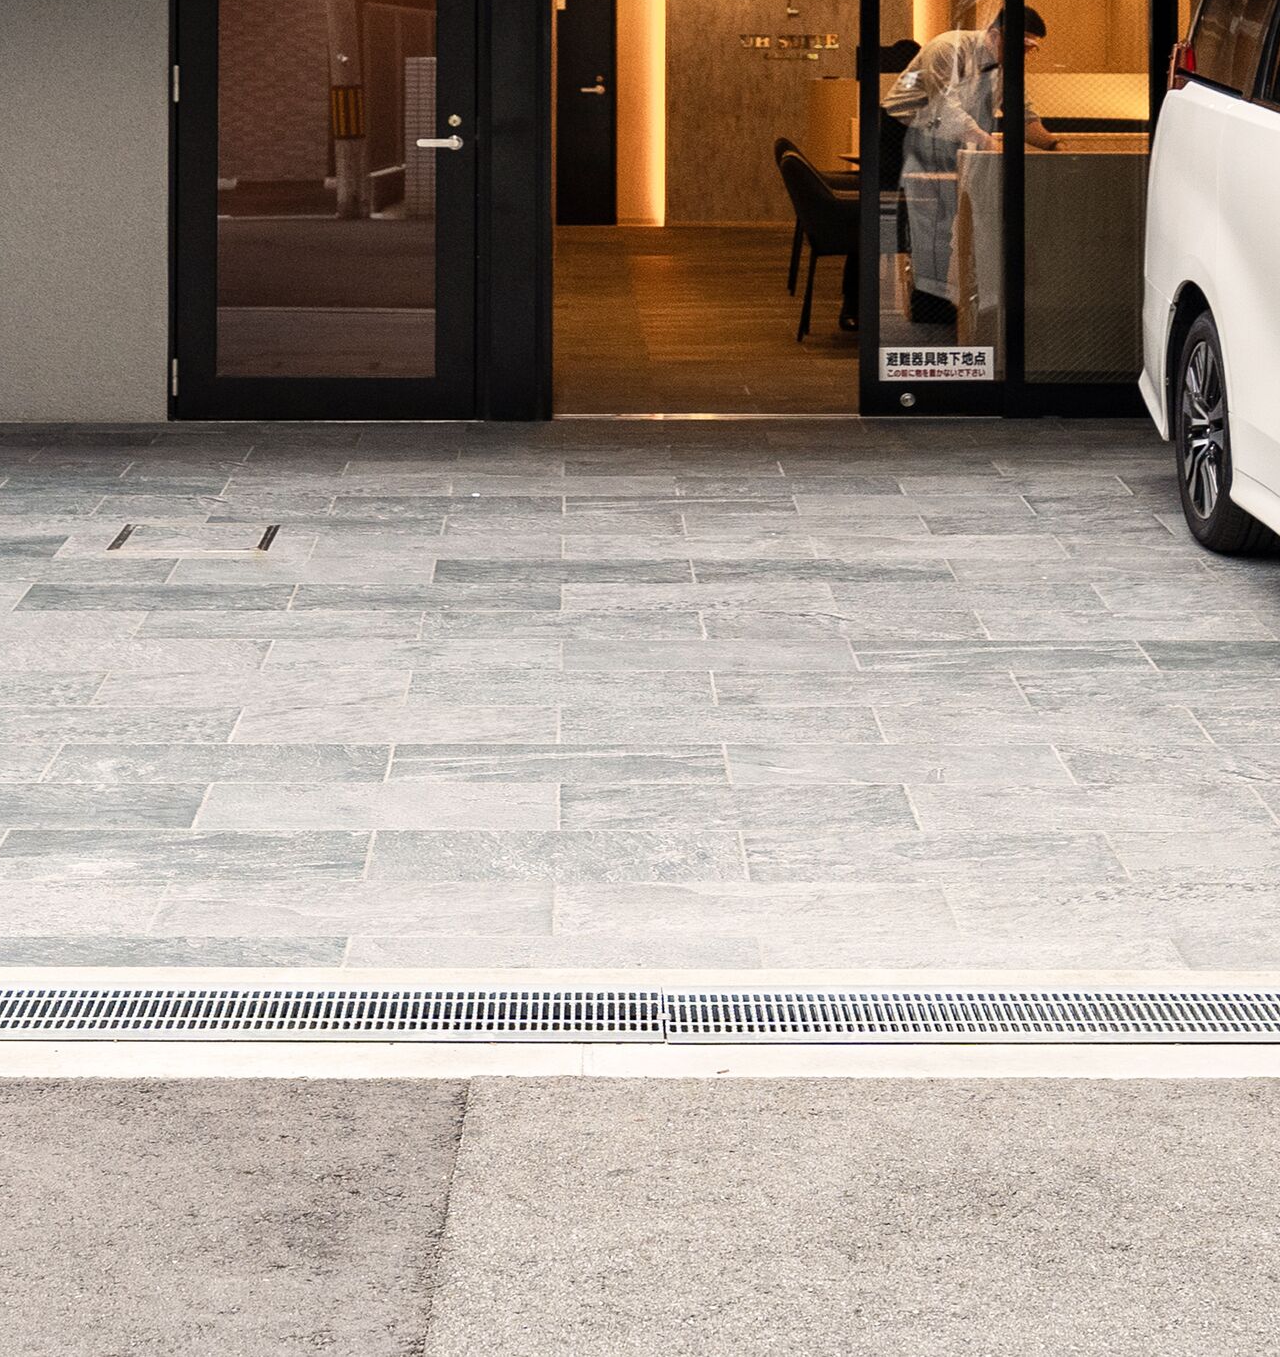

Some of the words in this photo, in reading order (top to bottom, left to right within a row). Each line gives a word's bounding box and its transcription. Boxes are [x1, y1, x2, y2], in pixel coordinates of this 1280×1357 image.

[886, 351, 987, 366] 避難器具降下地点
